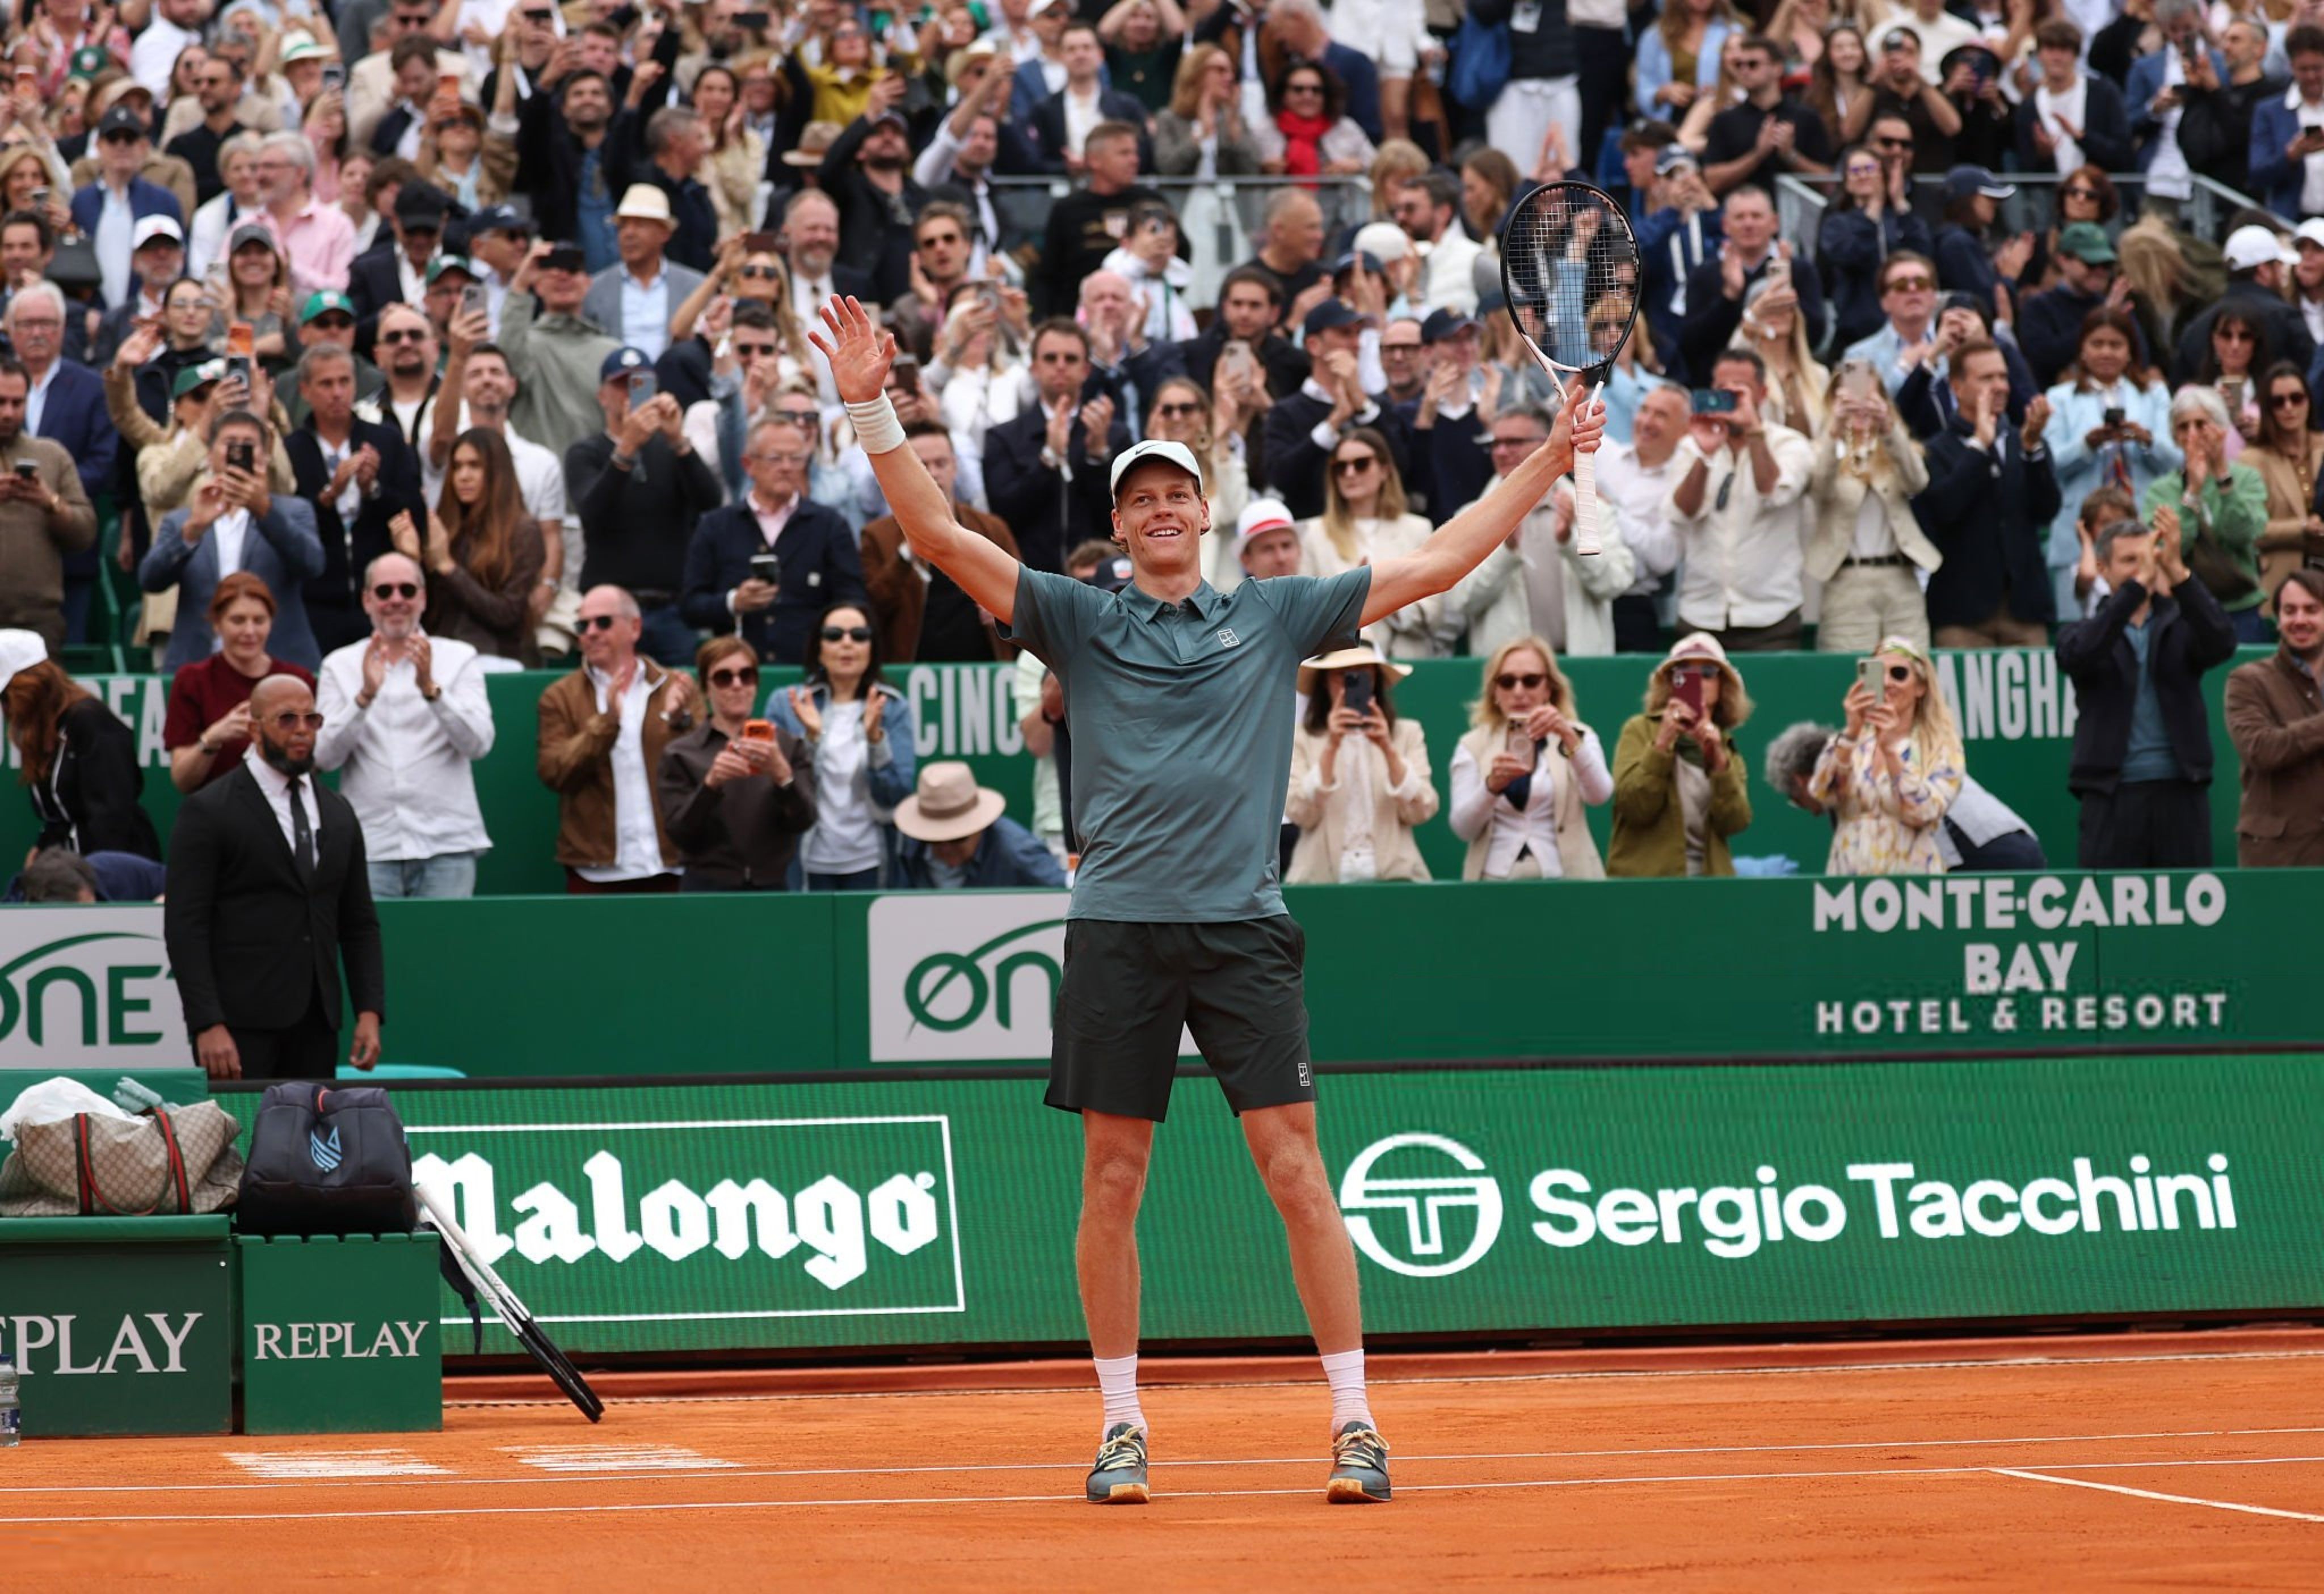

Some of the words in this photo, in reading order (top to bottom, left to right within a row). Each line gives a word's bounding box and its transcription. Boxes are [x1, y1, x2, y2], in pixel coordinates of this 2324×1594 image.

[1964, 942, 2078, 995] BAY
[1817, 1000, 1969, 1033] HOTEL
[1993, 999, 2017, 1030] &
[2043, 994, 2226, 1030] RESORT
[1529, 1165, 1847, 1258] Sergio
[1846, 1153, 2237, 1238] Tacchini
[0, 1313, 203, 1375] PLAY
[254, 1321, 430, 1360] REPLAY
